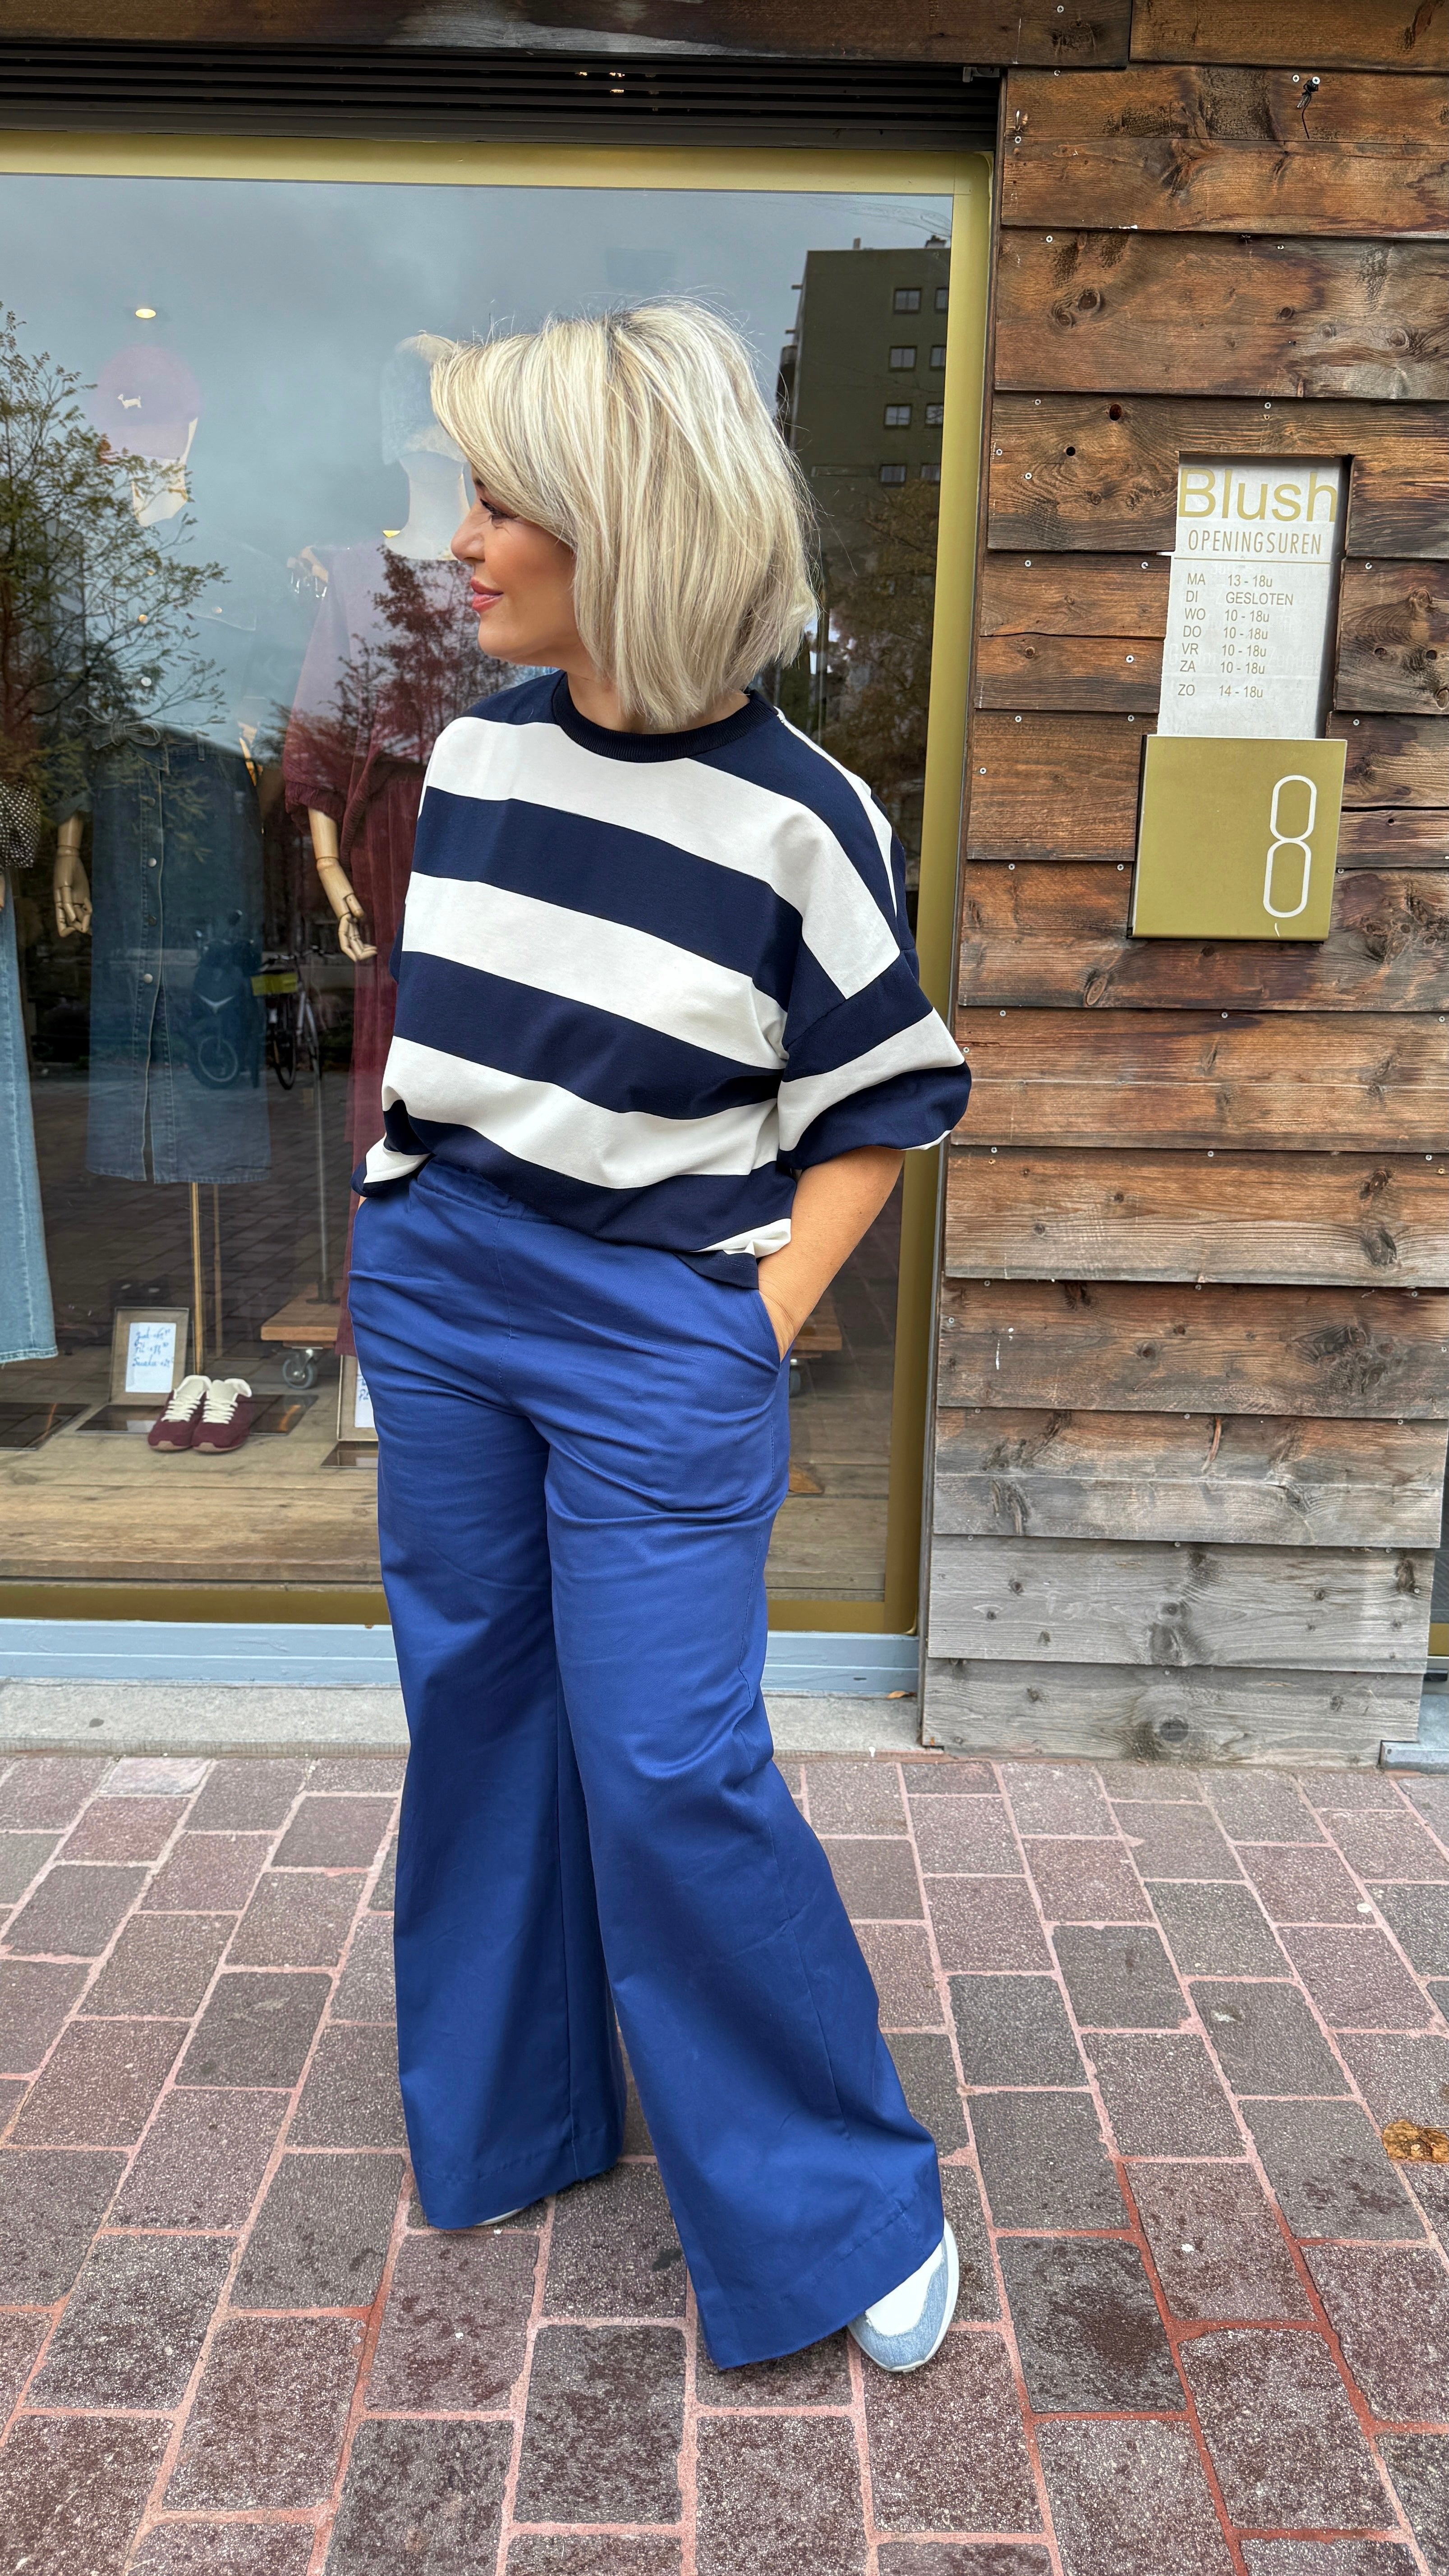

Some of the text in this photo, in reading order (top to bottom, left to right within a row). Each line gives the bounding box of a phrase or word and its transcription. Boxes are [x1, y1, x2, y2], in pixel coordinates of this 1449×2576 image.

[1178, 468, 1337, 522] Blush
[1188, 529, 1321, 555] OPENINGSUREN
[1187, 573, 1206, 585] MA
[1228, 574, 1241, 587] 13
[1252, 575, 1273, 588] 18u
[1186, 590, 1293, 606] DI GESLOTEN
[1185, 607, 1206, 621] WO
[1225, 609, 1238, 621] 10
[1250, 610, 1270, 622] 18u
[1183, 625, 1202, 638] DO
[1224, 626, 1236, 639] 10
[1249, 627, 1268, 640] 18u
[1182, 642, 1199, 655] VR
[1222, 644, 1235, 656] 10
[1247, 644, 1267, 657] 18u
[1179, 660, 1196, 672] ZA
[1220, 661, 1233, 673] 10
[1245, 662, 1265, 674] 18u
[1178, 684, 1195, 696] ZO
[1219, 685, 1232, 697] 14
[1244, 685, 1263, 698] 18u
[1263, 775, 1317, 918] 8
